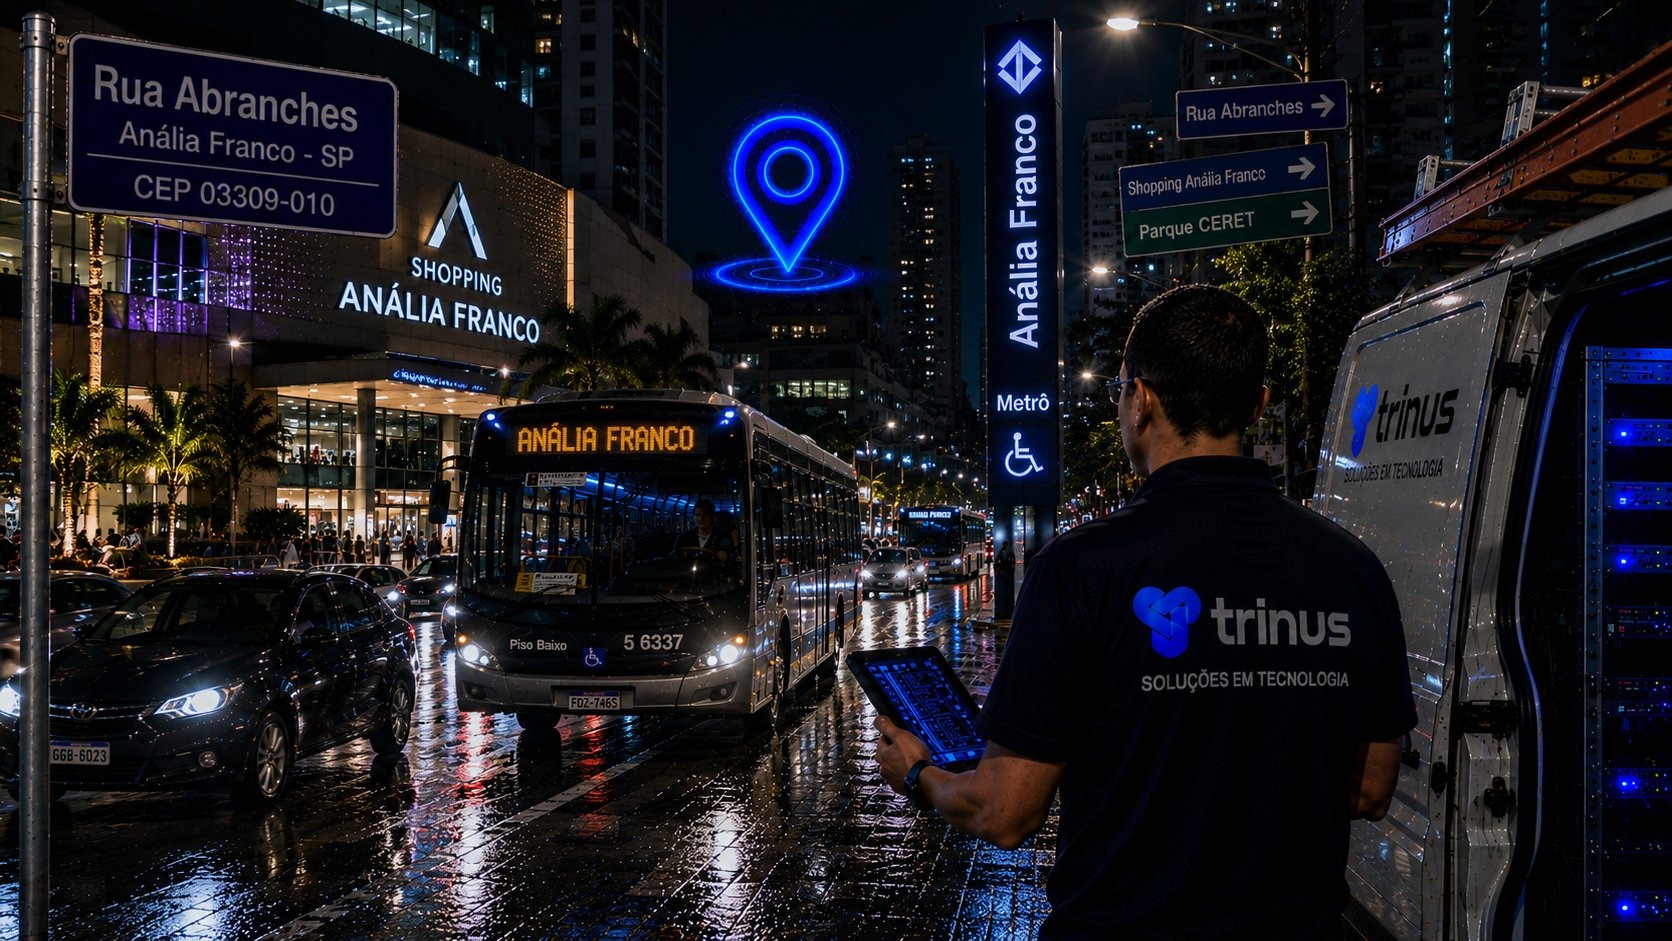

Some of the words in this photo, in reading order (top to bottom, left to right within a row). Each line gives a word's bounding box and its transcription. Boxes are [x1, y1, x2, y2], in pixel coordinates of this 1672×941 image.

[94, 64, 163, 109] Rua
[174, 75, 359, 133] Abranches
[1186, 105, 1216, 122] Rua
[1221, 99, 1304, 120] Abranches
[118, 120, 200, 153] Anália
[209, 131, 296, 164] Franco
[320, 144, 354, 169] SP
[1009, 113, 1038, 230] Franco
[1128, 177, 1182, 197] Shopping
[134, 174, 192, 202] CEP
[200, 181, 335, 217] 03309-010
[1139, 221, 1194, 240] Parque
[1198, 211, 1255, 233] CERET
[411, 256, 503, 297] SHOPPING
[1009, 240, 1039, 349] Anália
[338, 282, 447, 327] ANÁLIA
[453, 301, 541, 344] FRANCO
[997, 393, 1050, 412] Metrô
[1376, 383, 1459, 443] trinus
[517, 422, 597, 452] ANÁLIA
[606, 425, 695, 451] FRANCO
[1393, 458, 1443, 479] TECNOLOGIA
[1210, 597, 1351, 647] trinus
[510, 638, 533, 651] Piso
[537, 639, 567, 651] Baixo
[624, 634, 635, 650] 5
[640, 634, 684, 650] 6337
[1233, 671, 1254, 688] EM
[1257, 670, 1349, 688] TECNOLOGIA
